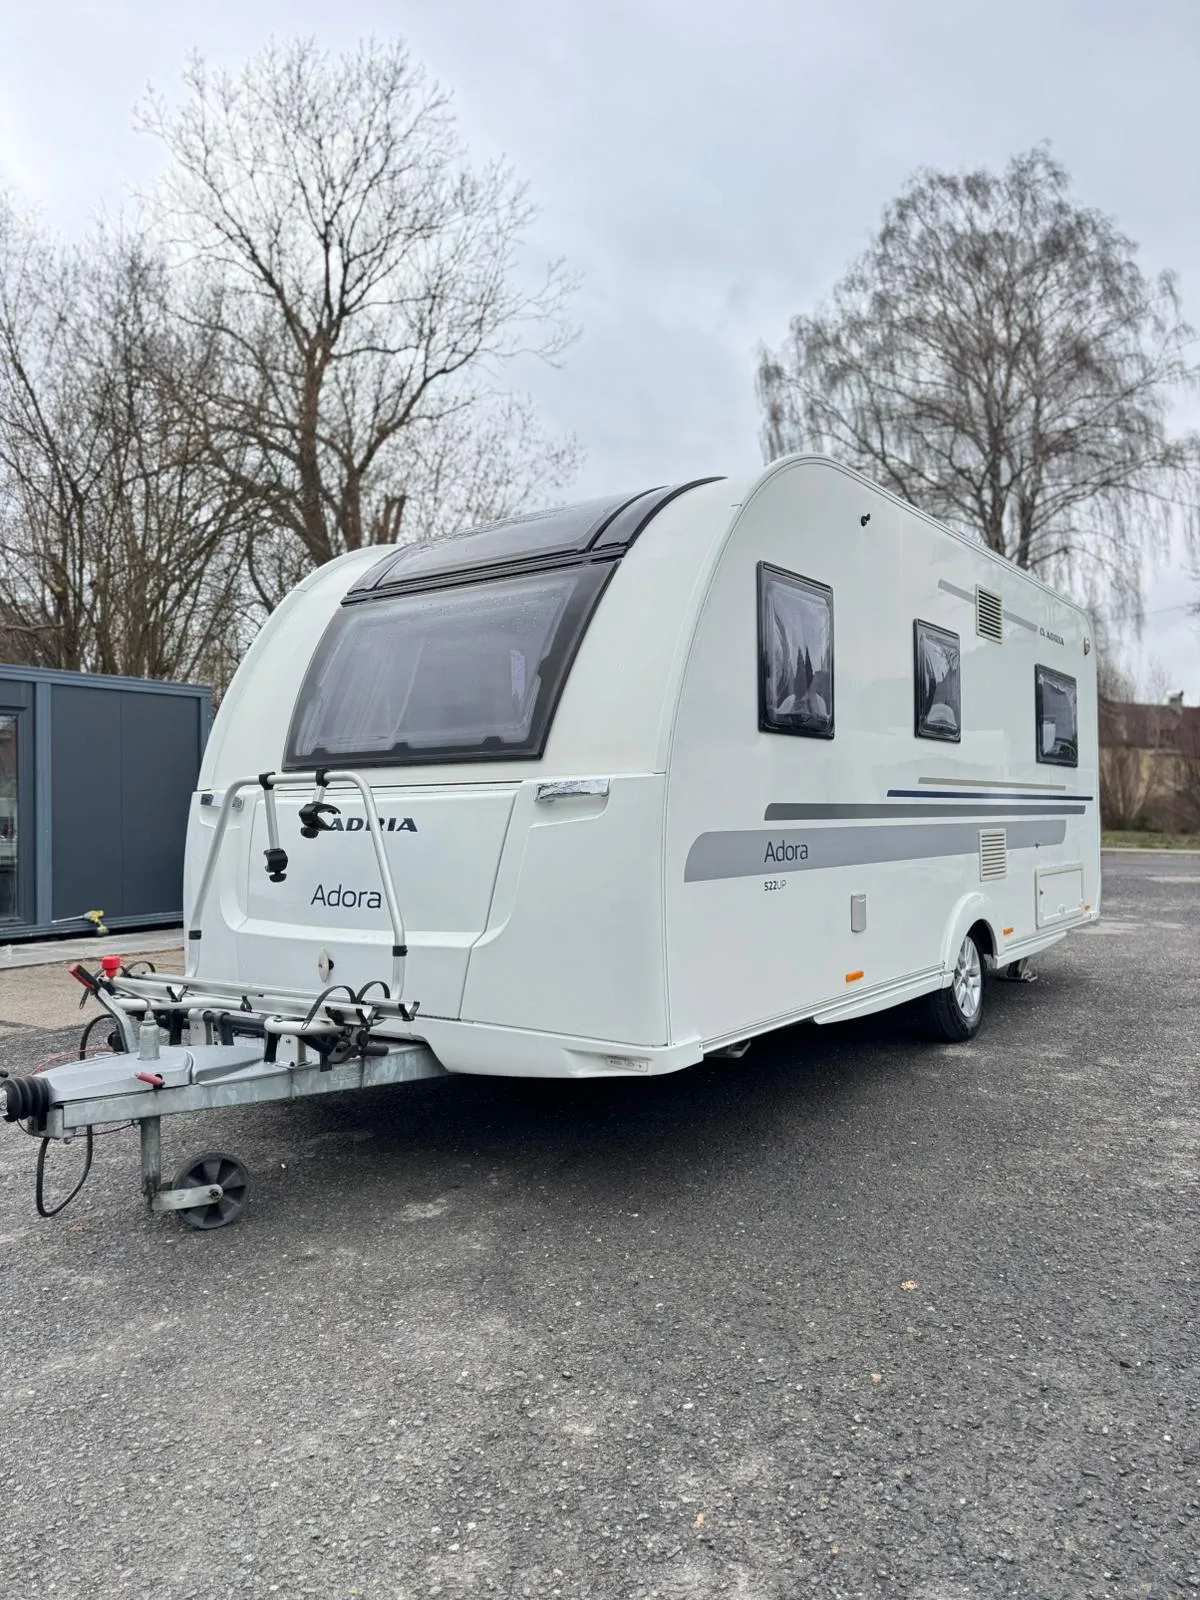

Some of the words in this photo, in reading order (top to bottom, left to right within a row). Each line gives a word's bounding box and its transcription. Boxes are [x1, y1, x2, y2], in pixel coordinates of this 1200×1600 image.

[764, 839, 809, 863] Adora
[310, 883, 382, 909] Adora
[764, 879, 787, 891] 522UP
